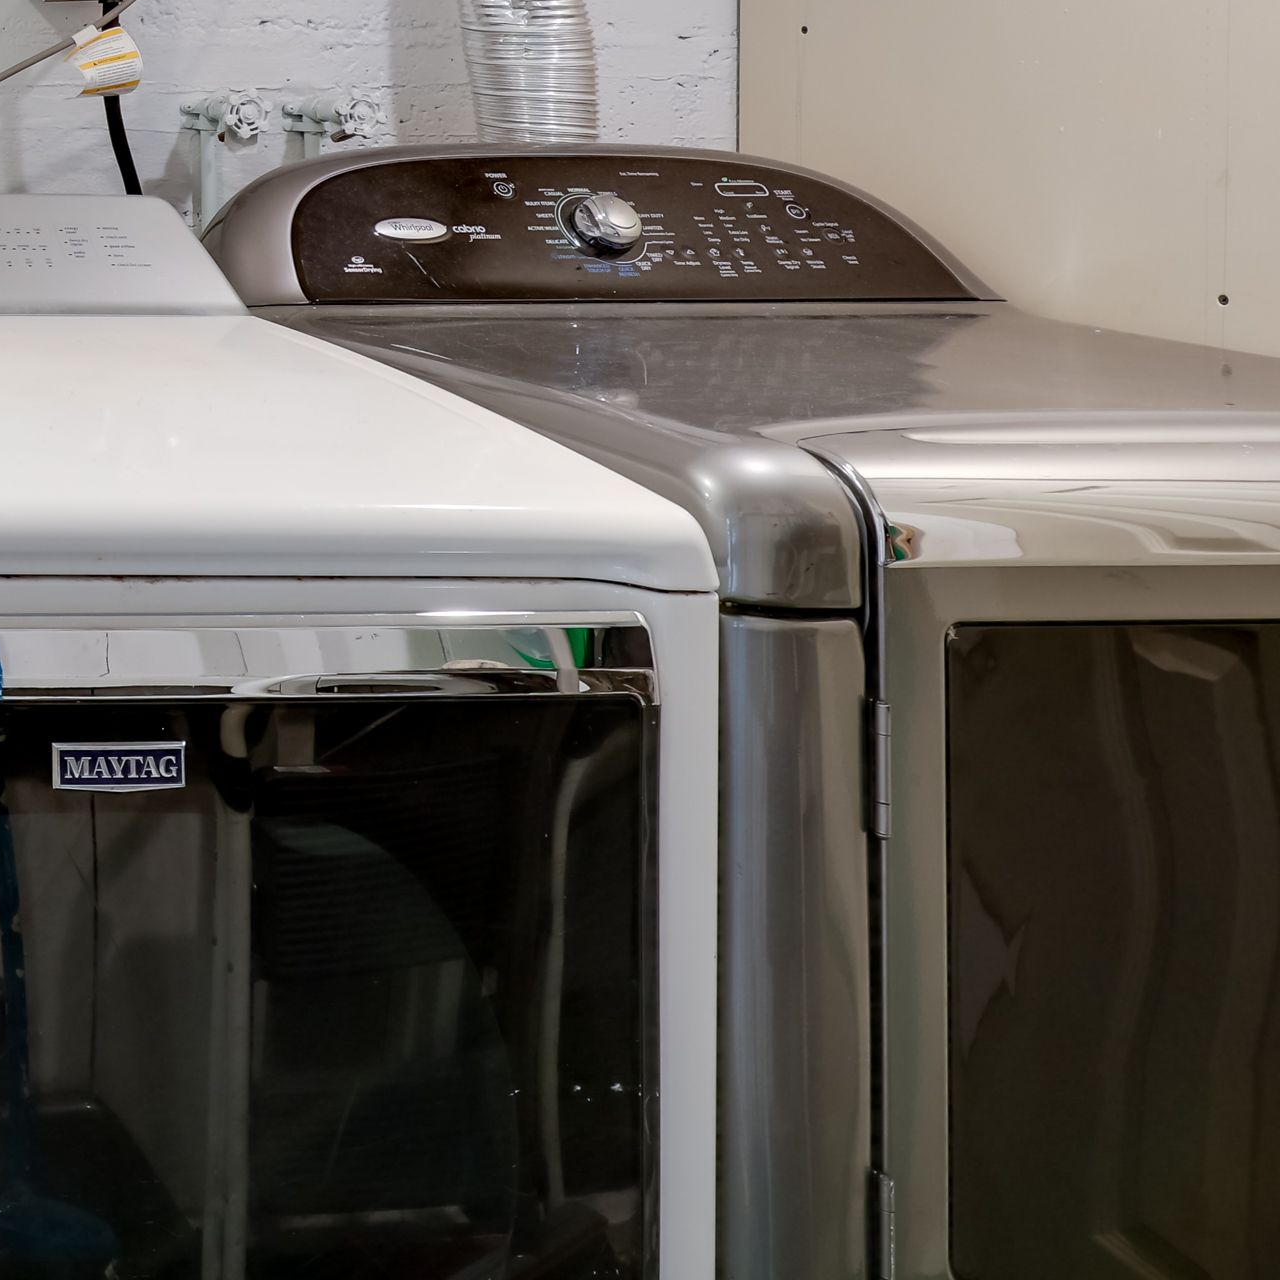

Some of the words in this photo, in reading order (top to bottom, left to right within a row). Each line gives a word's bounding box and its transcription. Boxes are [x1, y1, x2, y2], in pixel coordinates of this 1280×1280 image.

[391, 224, 433, 233] Whirlpool
[452, 225, 486, 233] cabrio
[469, 233, 502, 242] platinum
[64, 756, 179, 779] MAYTAG
